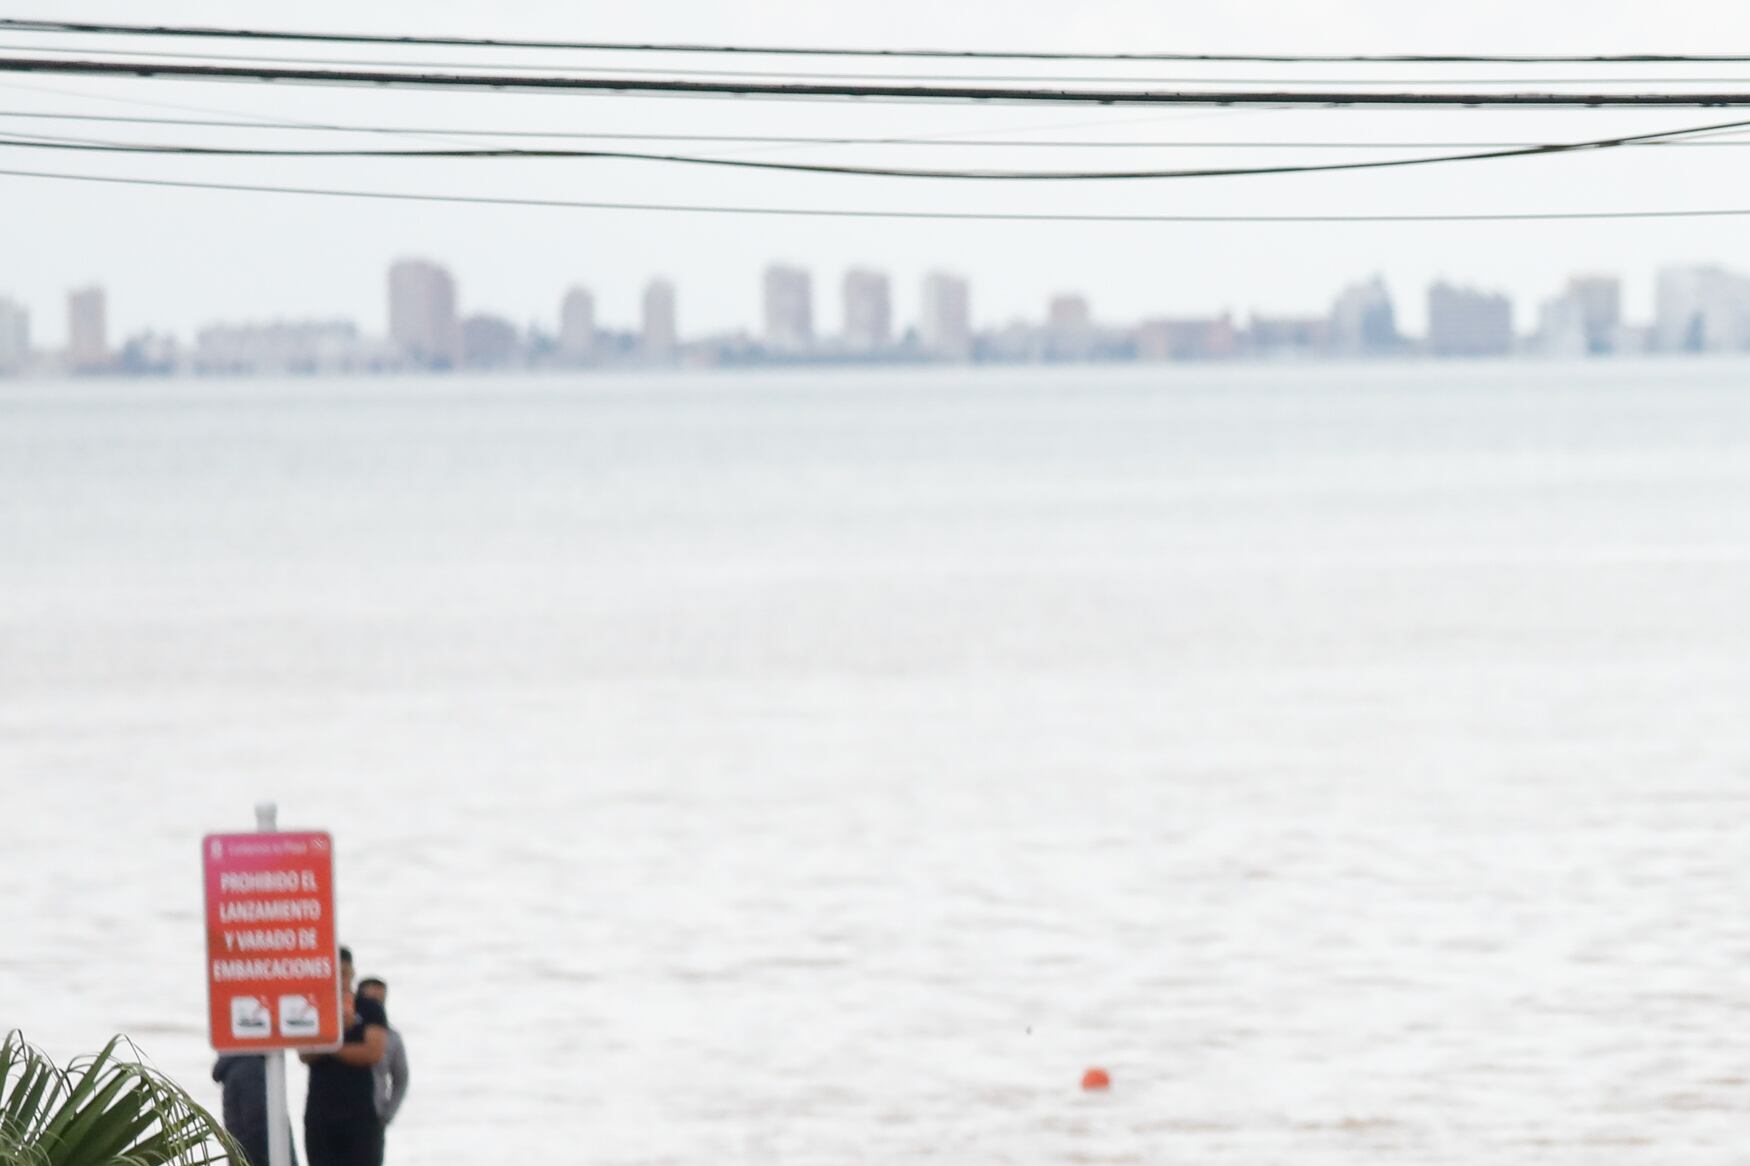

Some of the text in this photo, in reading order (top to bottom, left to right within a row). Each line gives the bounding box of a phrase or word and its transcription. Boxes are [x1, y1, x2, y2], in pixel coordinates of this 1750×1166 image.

[220, 869, 318, 893] PROHIBIDO EL
[219, 898, 321, 923] LANZAMIENTO
[223, 926, 318, 951] Y VARADO DE
[213, 957, 332, 982] EMBARCACIONES
